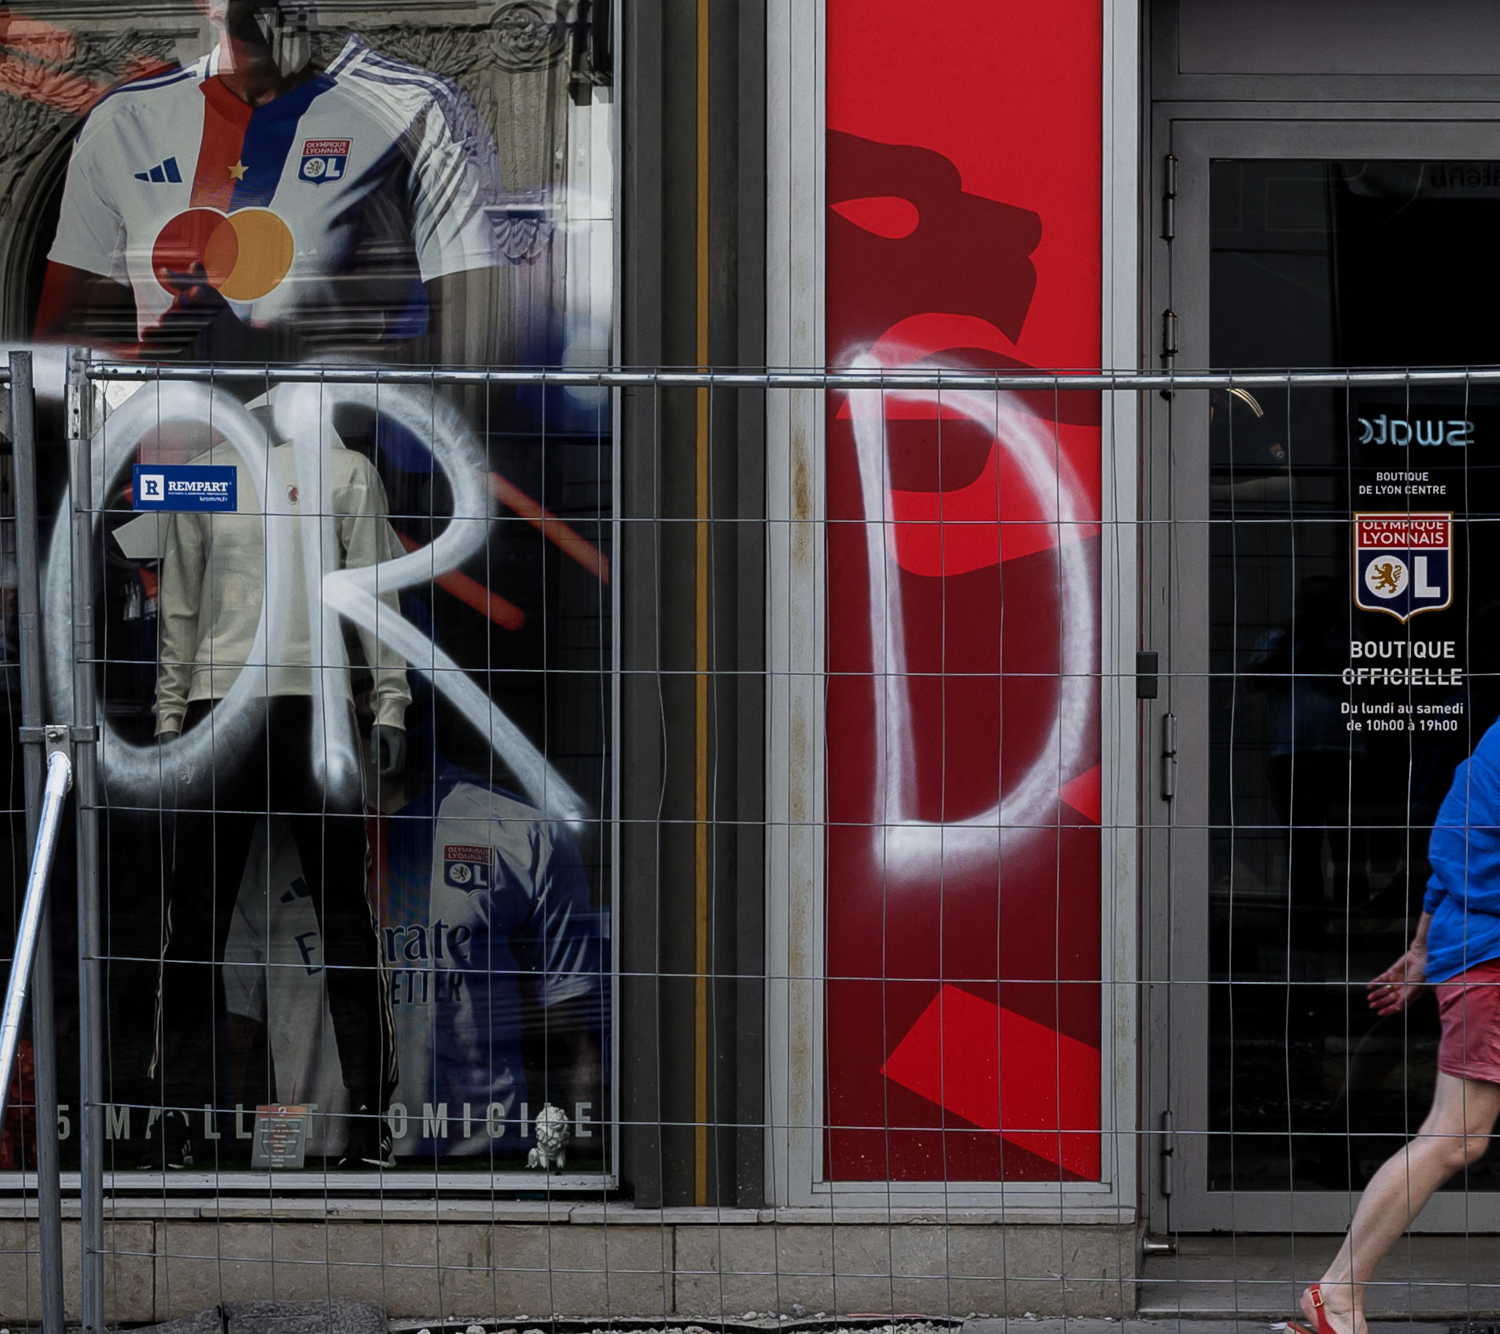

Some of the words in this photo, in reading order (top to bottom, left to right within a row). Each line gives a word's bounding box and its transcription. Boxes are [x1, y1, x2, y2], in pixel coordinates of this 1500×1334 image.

[1376, 471, 1430, 481] BOUTIQUE
[167, 481, 228, 492] REMPART
[1358, 485, 1373, 495] DE
[1375, 485, 1402, 495] LYON
[1405, 485, 1447, 495] CENTRE
[1362, 520, 1445, 531] OLYMPIQUE
[1362, 532, 1445, 545] LYONNAIS
[1350, 640, 1456, 659] BOUTIQUE
[1342, 667, 1463, 686] OFFICIELLE
[1340, 703, 1358, 714] Du
[1361, 702, 1394, 714] lundi
[1397, 705, 1413, 714] au
[1416, 702, 1464, 714] samedi
[1346, 720, 1362, 731] de
[1366, 720, 1405, 731] 10h00
[1419, 720, 1458, 731] 19h00
